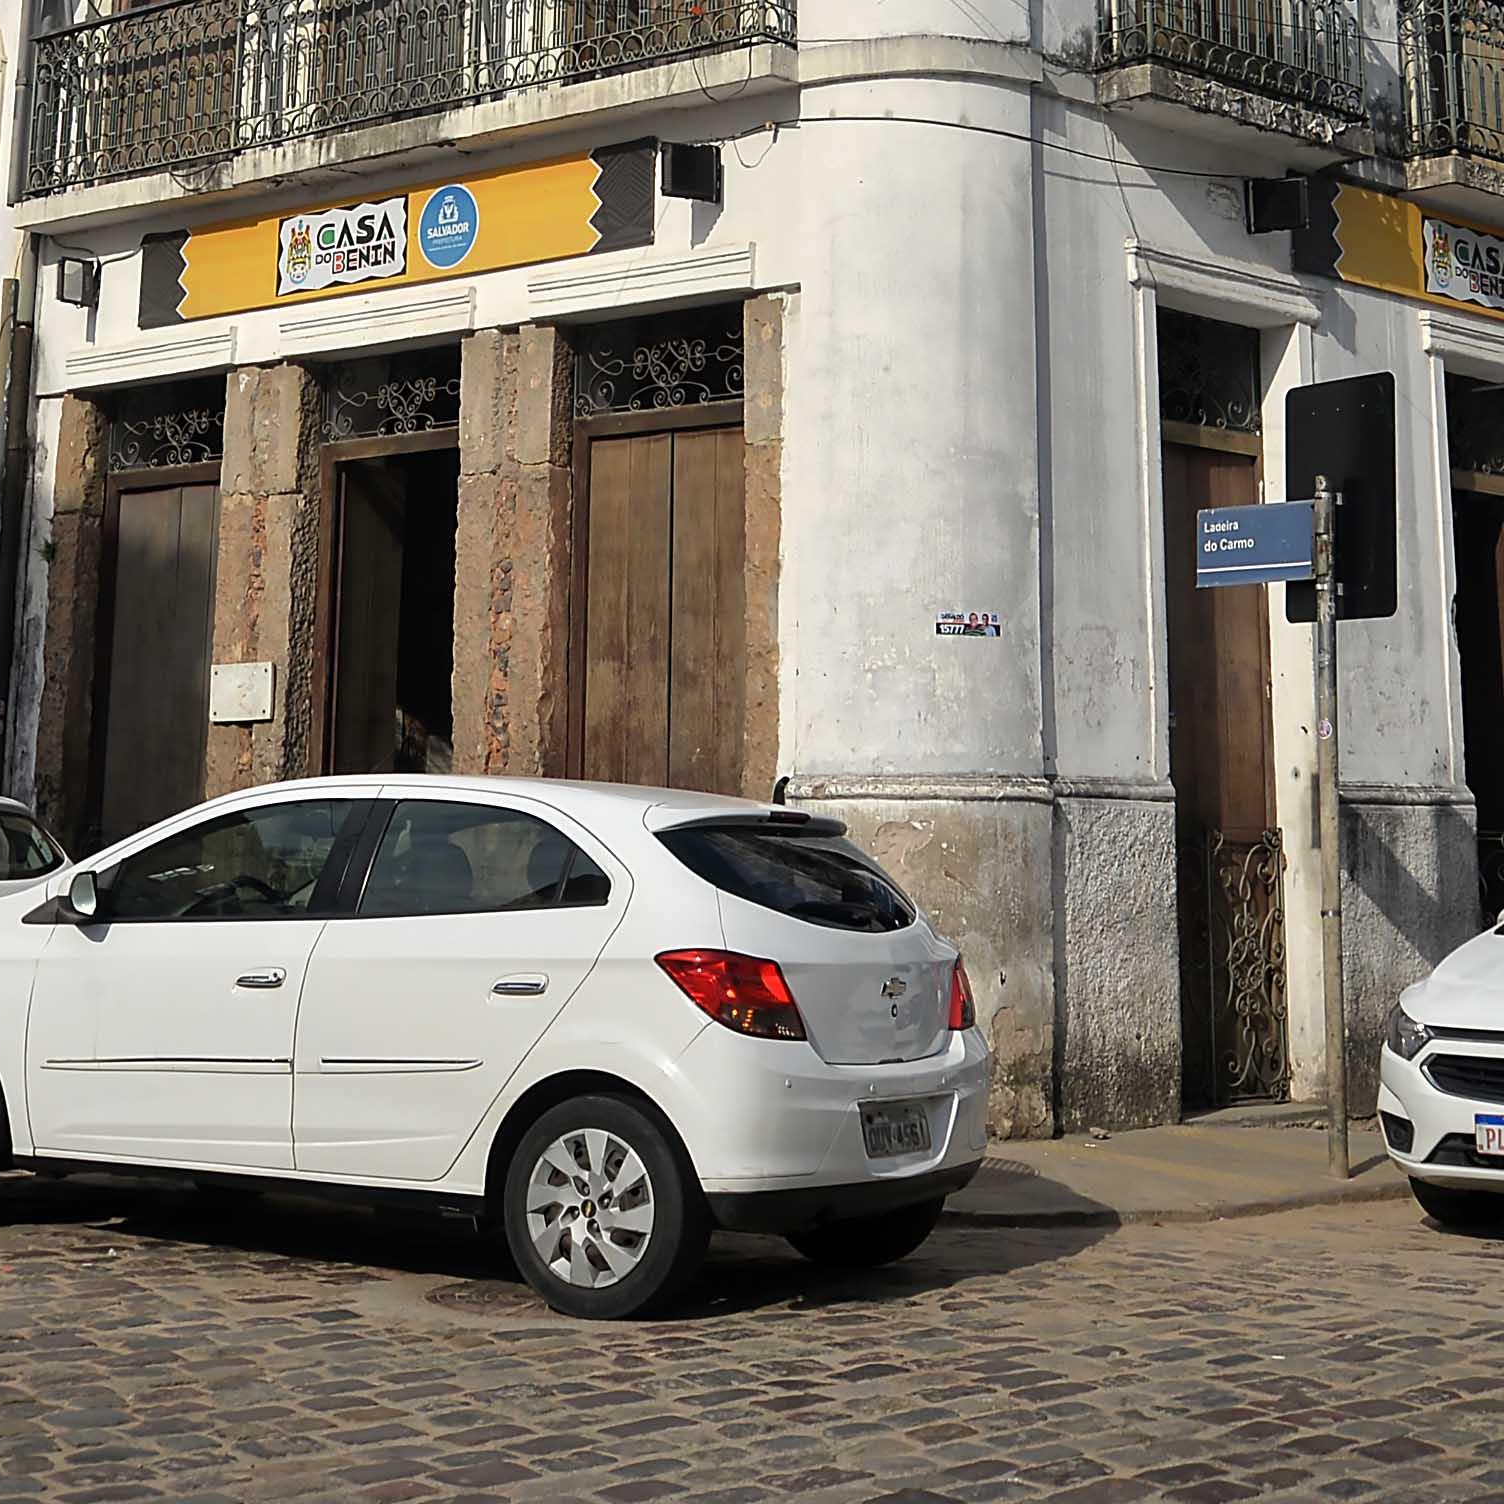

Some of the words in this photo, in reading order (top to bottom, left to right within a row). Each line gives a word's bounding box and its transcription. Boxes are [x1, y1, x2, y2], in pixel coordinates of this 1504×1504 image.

[316, 211, 395, 251] CASA
[427, 221, 469, 240] SALVADOR
[315, 253, 331, 265] DO
[332, 241, 395, 275] BENIN
[1455, 266, 1469, 279] DO
[1204, 520, 1239, 533] Ladeira
[1204, 539, 1217, 552] do
[1219, 538, 1255, 551] Carmo
[939, 624, 965, 634] 15777
